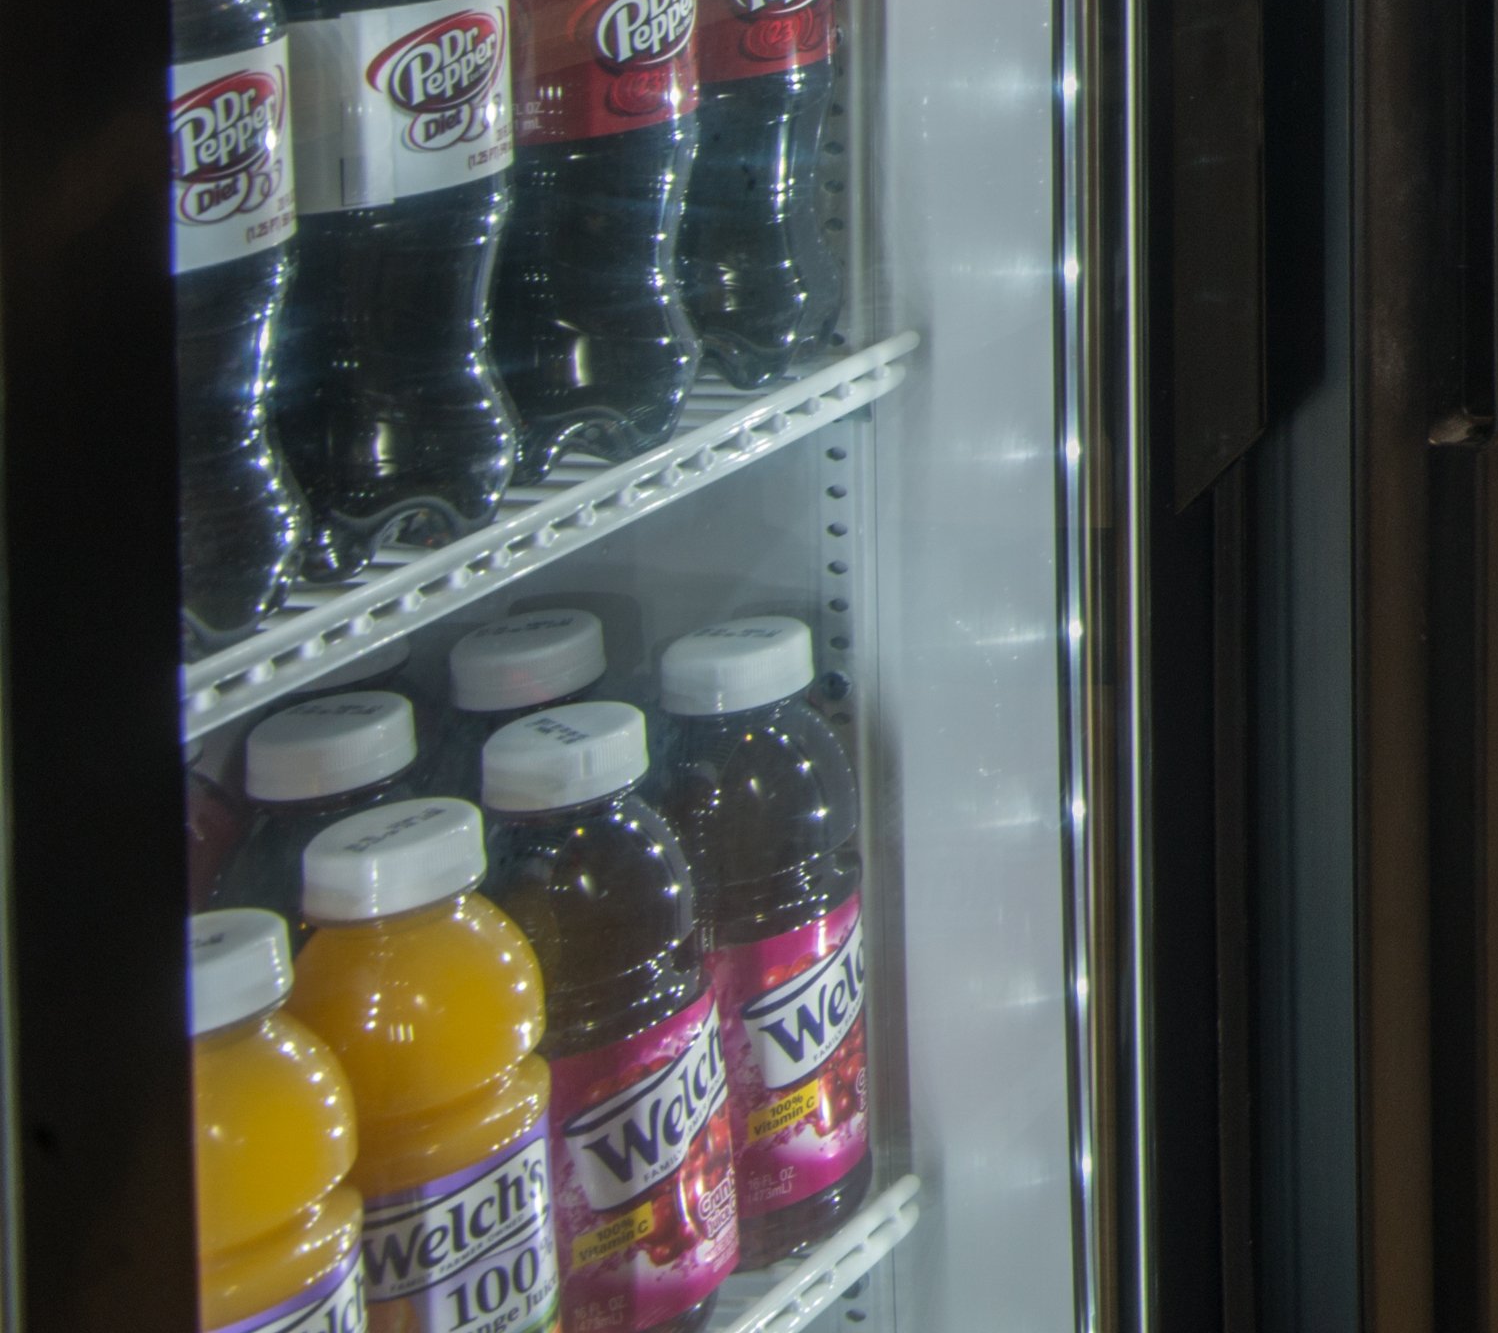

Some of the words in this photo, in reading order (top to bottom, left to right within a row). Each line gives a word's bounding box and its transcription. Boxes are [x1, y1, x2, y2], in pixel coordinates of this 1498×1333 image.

[439, 25, 479, 59] Dr
[390, 32, 496, 107] Pepper
[212, 86, 257, 121] Dr
[173, 95, 275, 178] Pepper
[422, 107, 463, 143] Diet
[196, 178, 241, 216] Diet
[751, 1103, 805, 1133] Vitamin
[805, 1094, 817, 1110] C
[769, 1094, 804, 1118] 100%
[363, 1158, 546, 1290] Welch's
[576, 1225, 637, 1264] Vitamin
[637, 1218, 650, 1234] C
